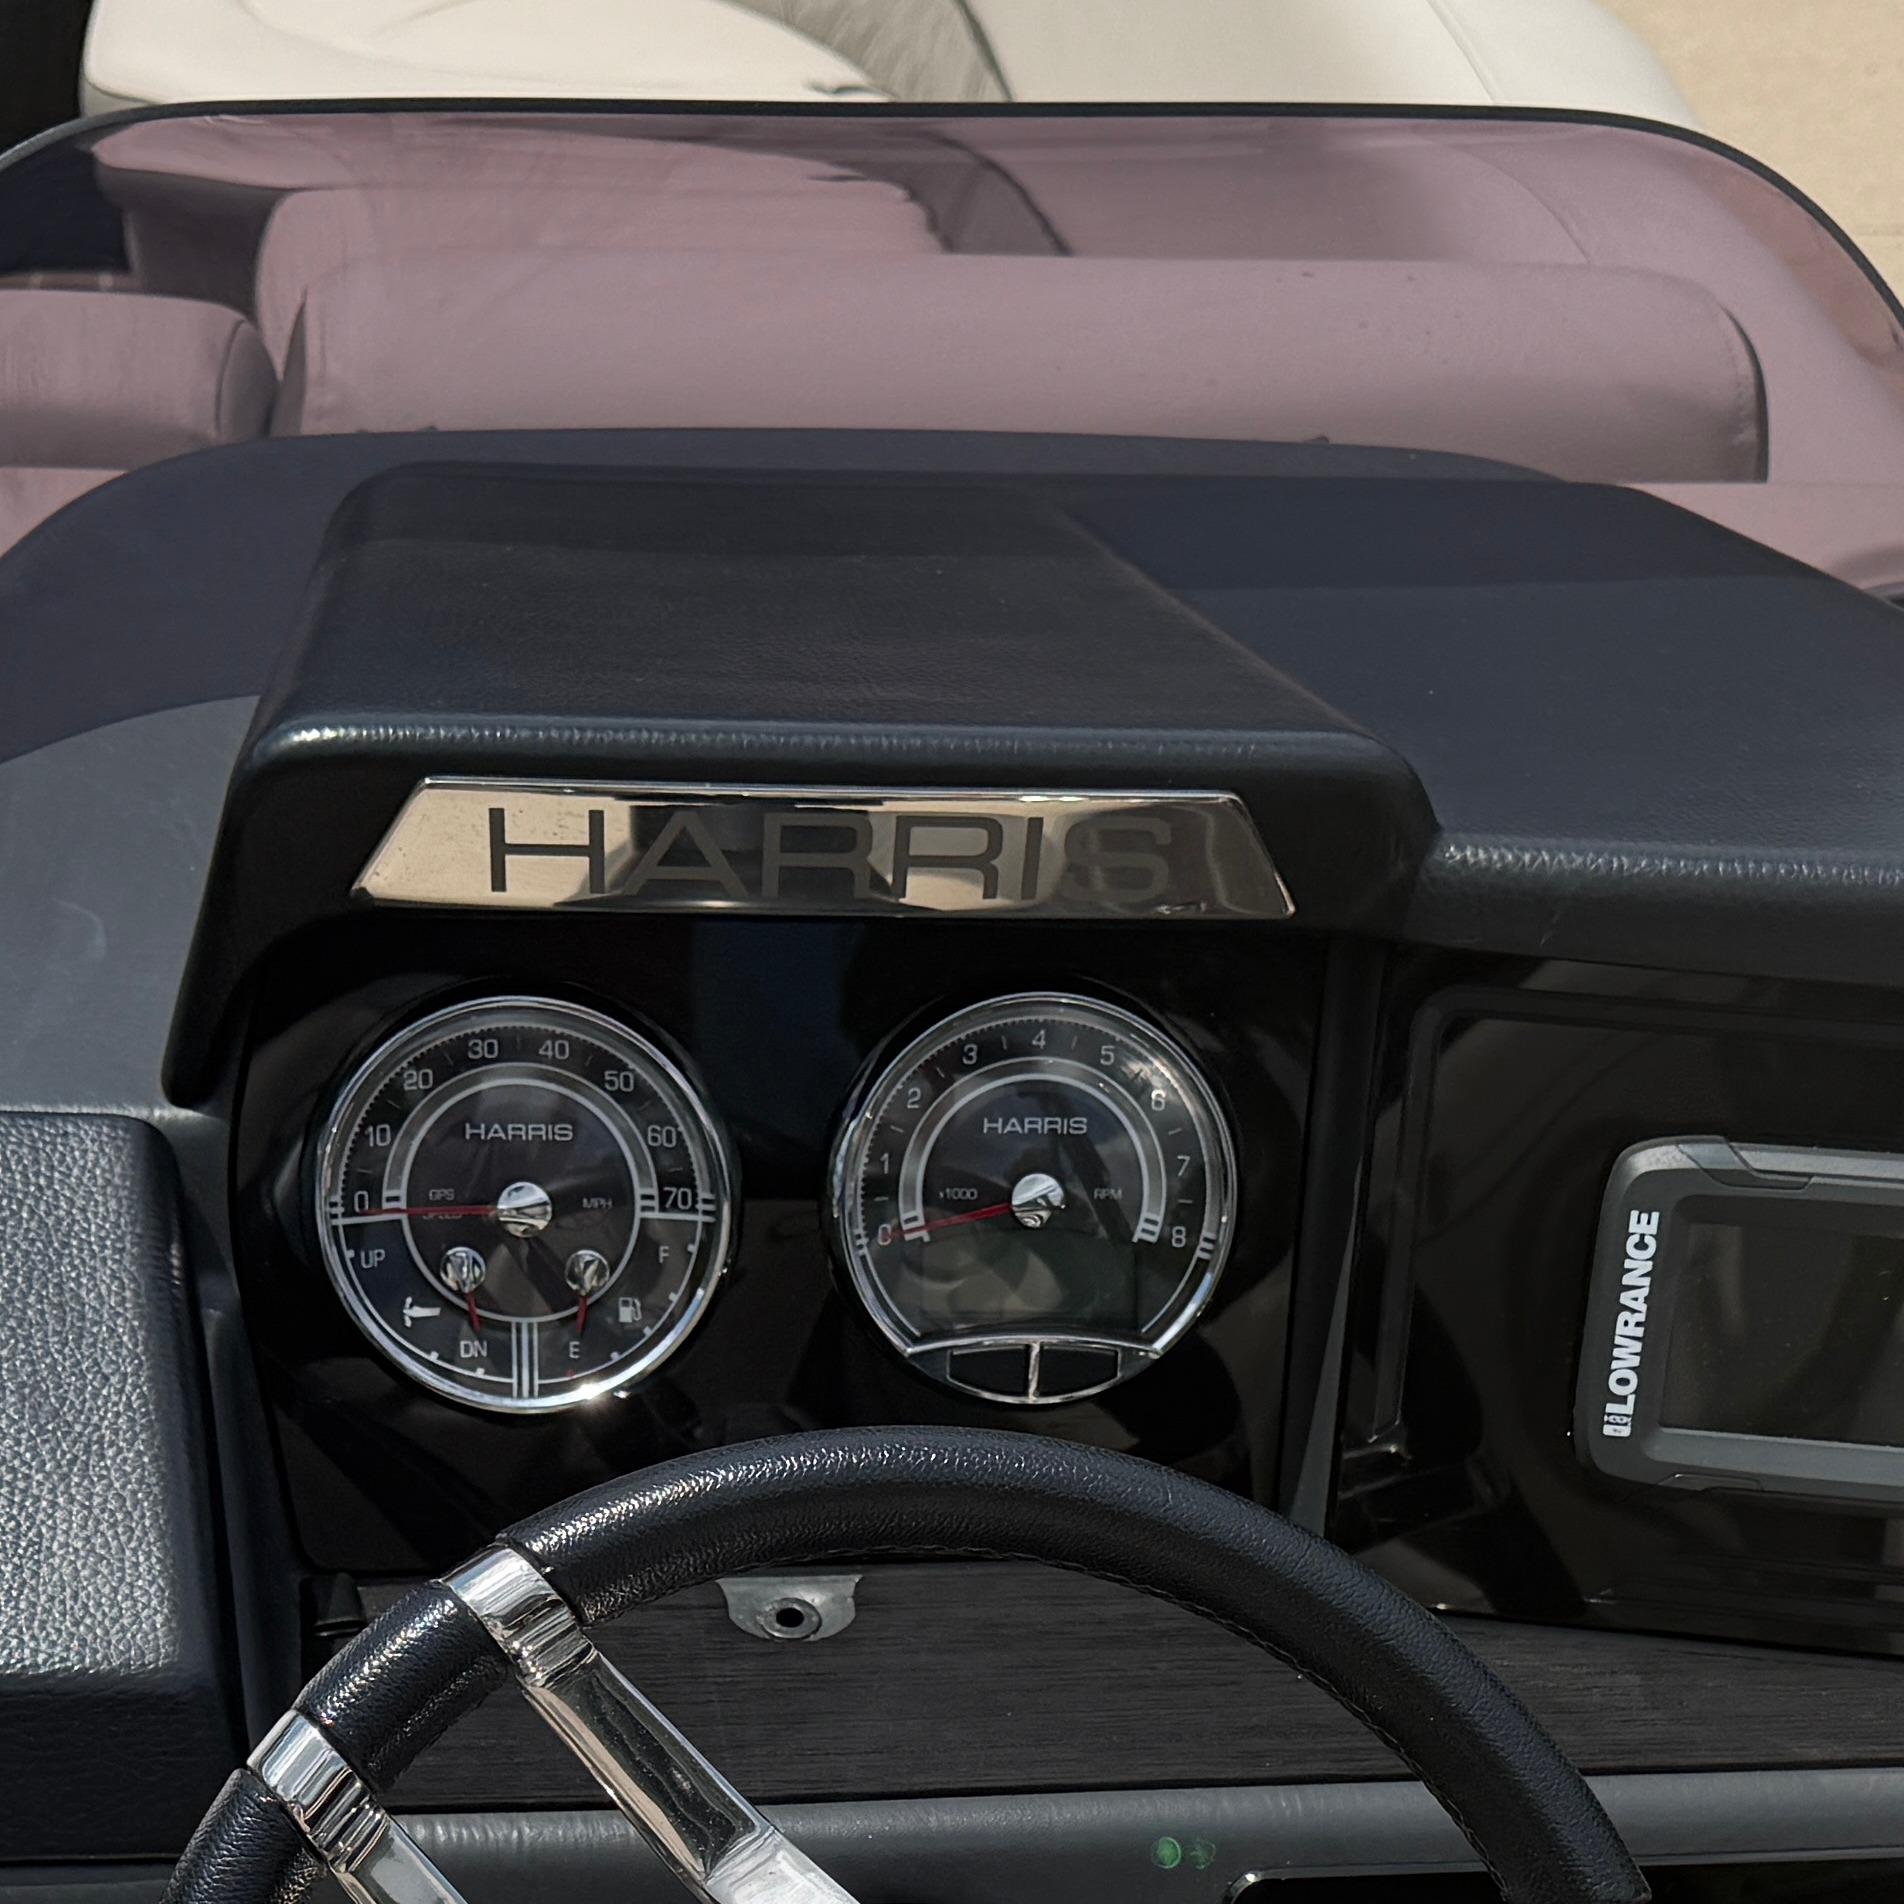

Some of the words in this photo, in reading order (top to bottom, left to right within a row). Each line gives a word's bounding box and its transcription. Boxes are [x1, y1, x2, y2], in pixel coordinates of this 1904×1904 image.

[488, 806, 1172, 904] HARRIS
[468, 1040, 498, 1059] 30
[1032, 1030, 1046, 1049] 4
[539, 1041, 570, 1060] 40
[962, 1044, 978, 1065] 3
[1100, 1044, 1114, 1065] 5
[403, 1069, 433, 1090] 20
[604, 1071, 635, 1092] 50
[907, 1088, 922, 1108] 2
[1151, 1089, 1166, 1111] 6
[367, 1125, 392, 1146] 10
[464, 1123, 574, 1141] HARRIS
[983, 1117, 1088, 1135] HARRIS
[647, 1126, 676, 1148] 60
[880, 1153, 889, 1174] 1
[1176, 1156, 1190, 1177] 7
[354, 1191, 368, 1213] 0
[582, 1198, 612, 1210] MPH
[664, 1188, 692, 1210] 70
[1094, 1188, 1122, 1200] RPM
[1171, 1226, 1186, 1248] 8
[360, 1249, 386, 1270] UP
[659, 1246, 670, 1264] F
[1605, 1210, 1660, 1415] LOWRANCE
[459, 1341, 488, 1358] DN
[569, 1341, 580, 1358] E
